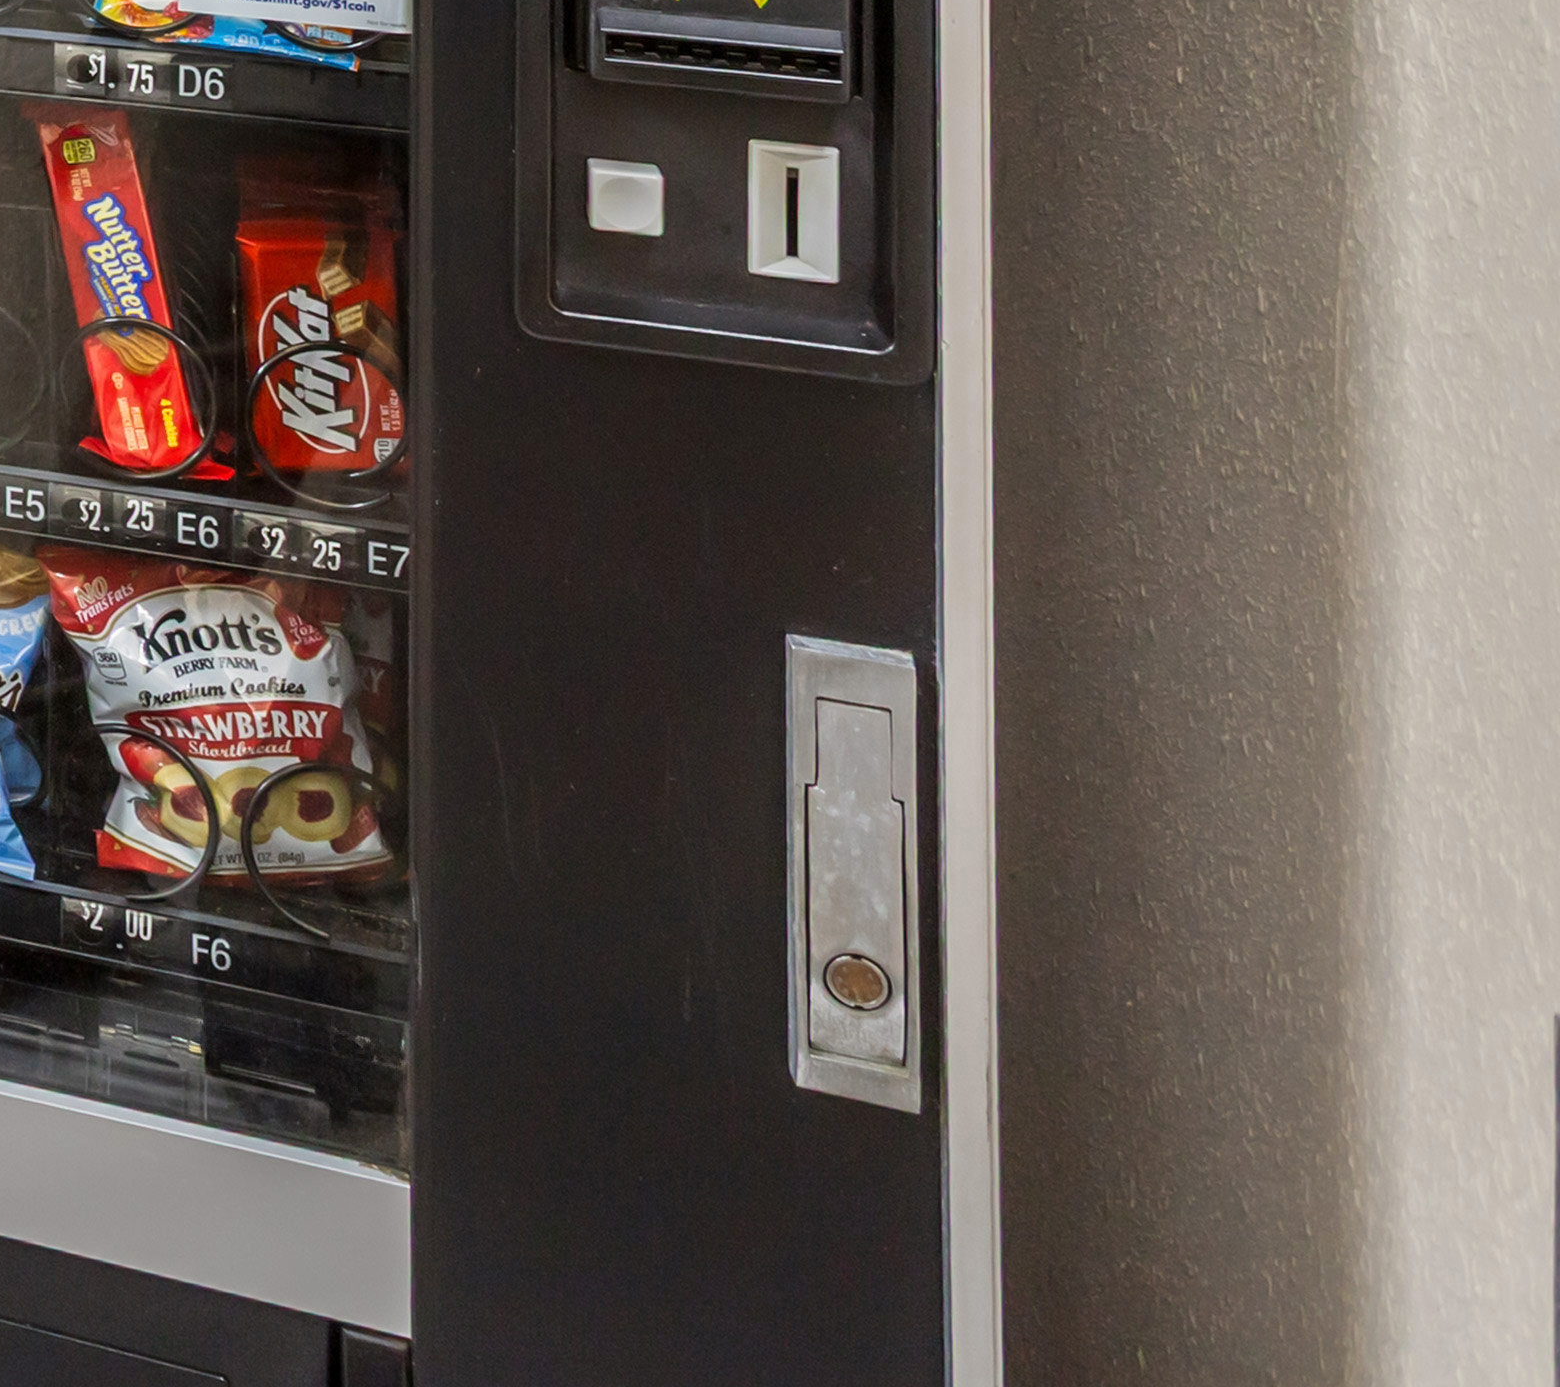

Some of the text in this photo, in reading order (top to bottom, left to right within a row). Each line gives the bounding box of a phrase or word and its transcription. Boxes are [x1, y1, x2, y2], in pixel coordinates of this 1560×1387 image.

[178, 66, 225, 98] D6
[5, 489, 45, 522] E5
[176, 515, 219, 548] E6
[367, 543, 409, 576] E7
[137, 610, 283, 660] Knott's
[174, 659, 215, 676] BERRY
[140, 678, 306, 707] Premium Cookies
[140, 710, 327, 741] STRAWBERRY
[192, 933, 232, 971] F6
